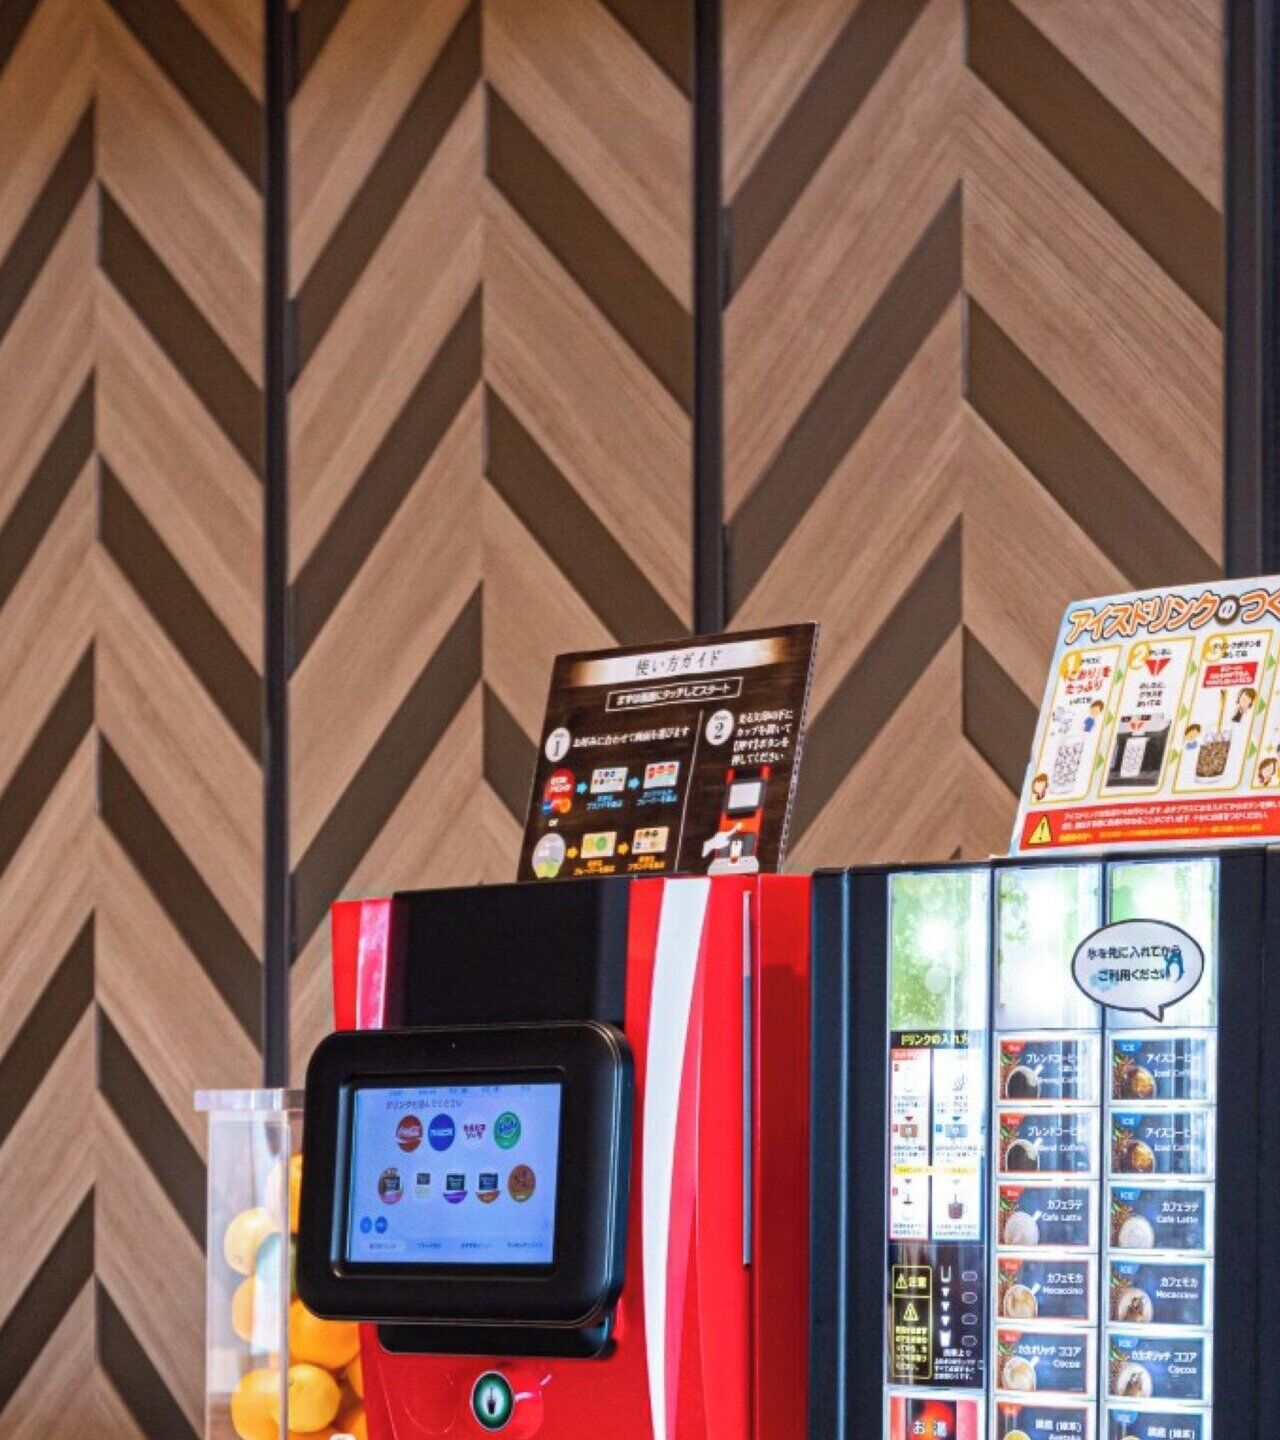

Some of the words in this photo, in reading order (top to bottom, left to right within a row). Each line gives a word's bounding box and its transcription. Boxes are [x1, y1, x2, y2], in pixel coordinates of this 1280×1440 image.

[1026, 1053, 1082, 1064] ブレンドコーヒ
[1027, 1127, 1084, 1138] ブレンドコーヒ
